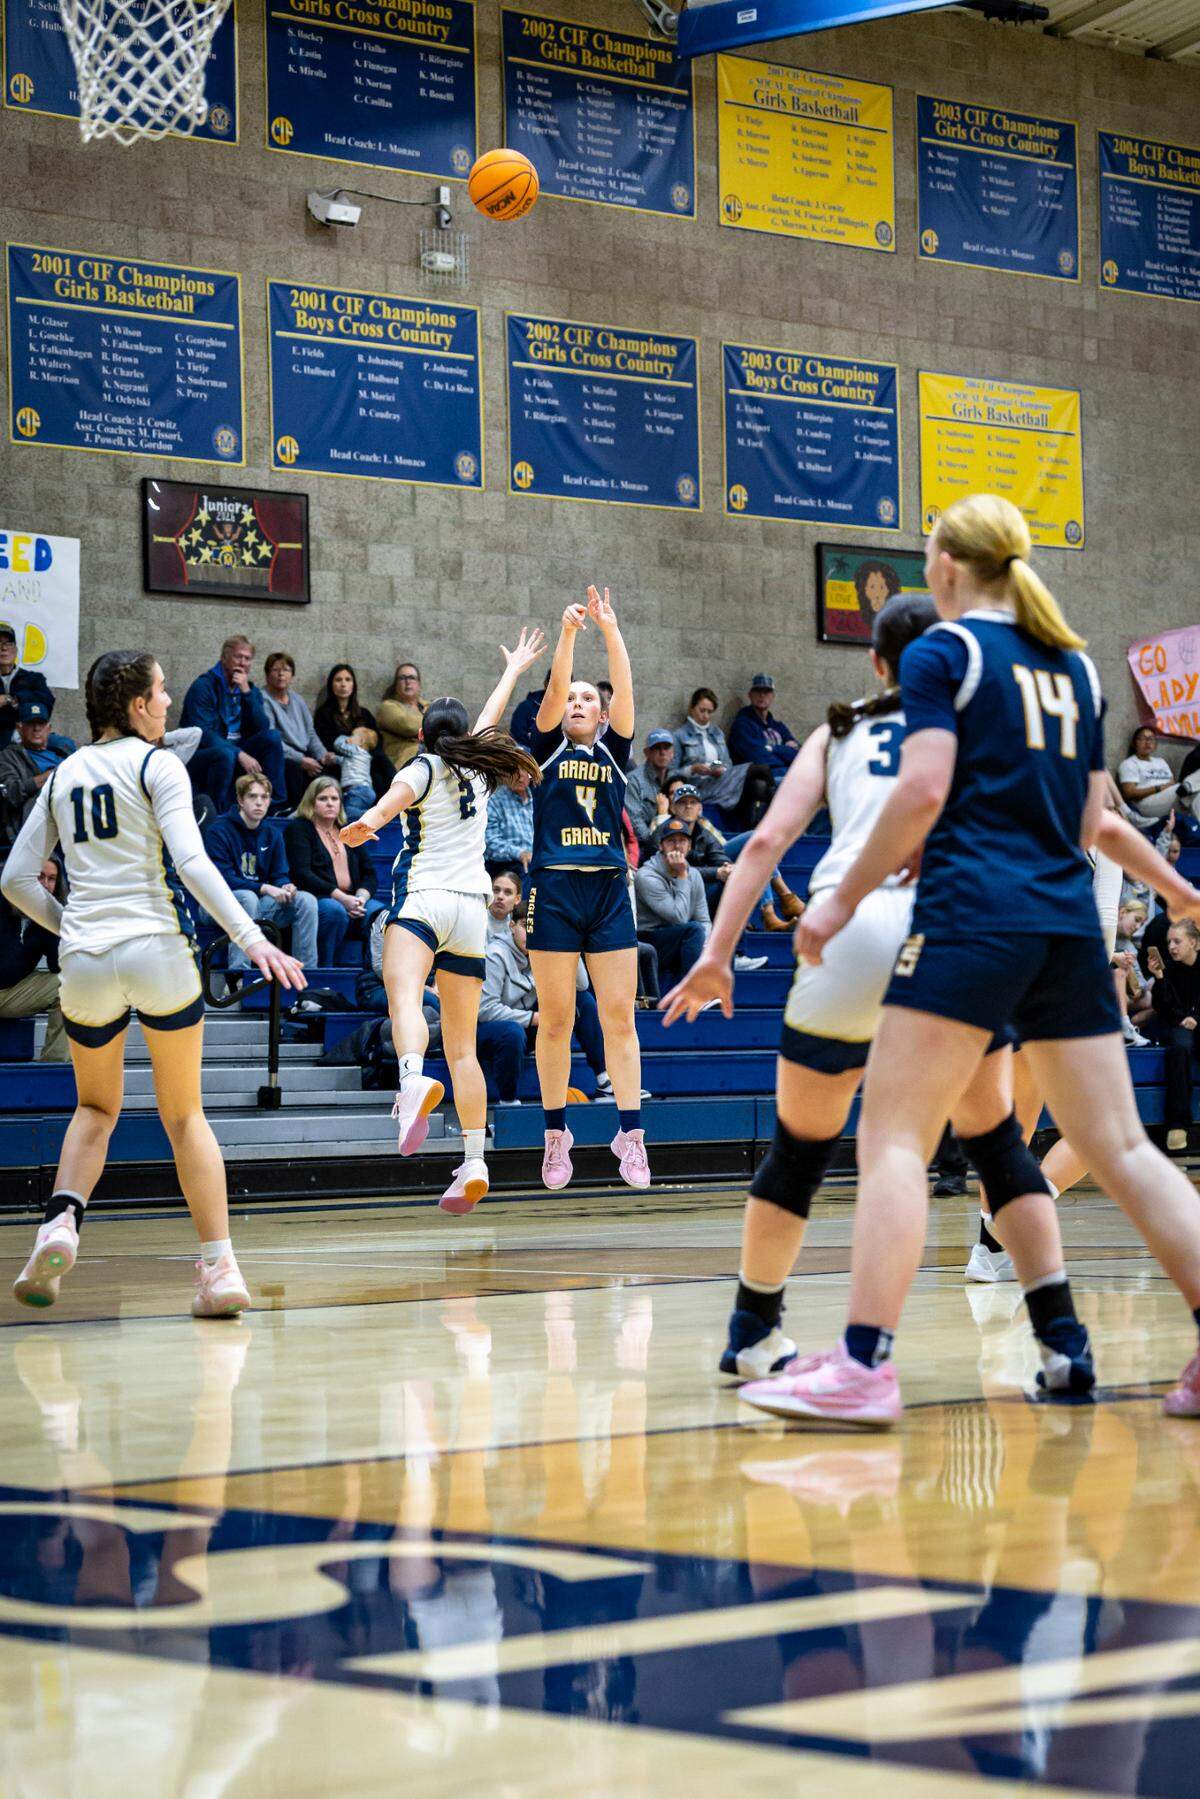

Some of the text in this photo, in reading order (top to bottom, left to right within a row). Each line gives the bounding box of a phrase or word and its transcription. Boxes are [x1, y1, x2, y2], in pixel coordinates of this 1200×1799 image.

[335, 1, 380, 26] Cross
[384, 11, 450, 43] Country
[521, 18, 673, 64] 2002 CIF Champions
[540, 41, 656, 79] Girls Basketball
[754, 88, 787, 108] Girls
[792, 96, 859, 122] Basketball
[932, 102, 1060, 140] 2003 CIF Champions
[324, 133, 346, 146] Head
[935, 120, 1058, 160] Girls Cross Country
[1142, 144, 1165, 162] CIF
[1128, 157, 1156, 178] Boys
[32, 253, 216, 296] 2001 CIF Champions
[54, 278, 195, 314] Girls Basketball
[290, 289, 456, 328] 2001 CIF Champions
[42, 316, 69, 328] Glaser
[114, 326, 142, 338] Wilson
[296, 310, 453, 351] Boys Cross Country
[526, 322, 678, 358] 2002 CIF Champions
[39, 358, 72, 370] Walters
[112, 352, 139, 364] Brown
[113, 367, 144, 379] Charles
[530, 341, 674, 379] Girls Cross Country
[740, 351, 879, 386] 2003 CIF Champions
[746, 370, 876, 406] Boys Cross Country
[16, 406, 42, 438] CIF
[80, 410, 103, 422] Head
[104, 412, 136, 425] Coach:
[952, 402, 983, 420] Girls
[986, 407, 1048, 427] Basketball
[330, 448, 352, 460] Head
[202, 495, 250, 514] Juniors
[1139, 642, 1167, 676] GO
[1012, 664, 1079, 759] 14
[868, 722, 904, 777] 3
[70, 783, 118, 844] 10
[458, 779, 476, 820] 2
[575, 785, 597, 824] 4
